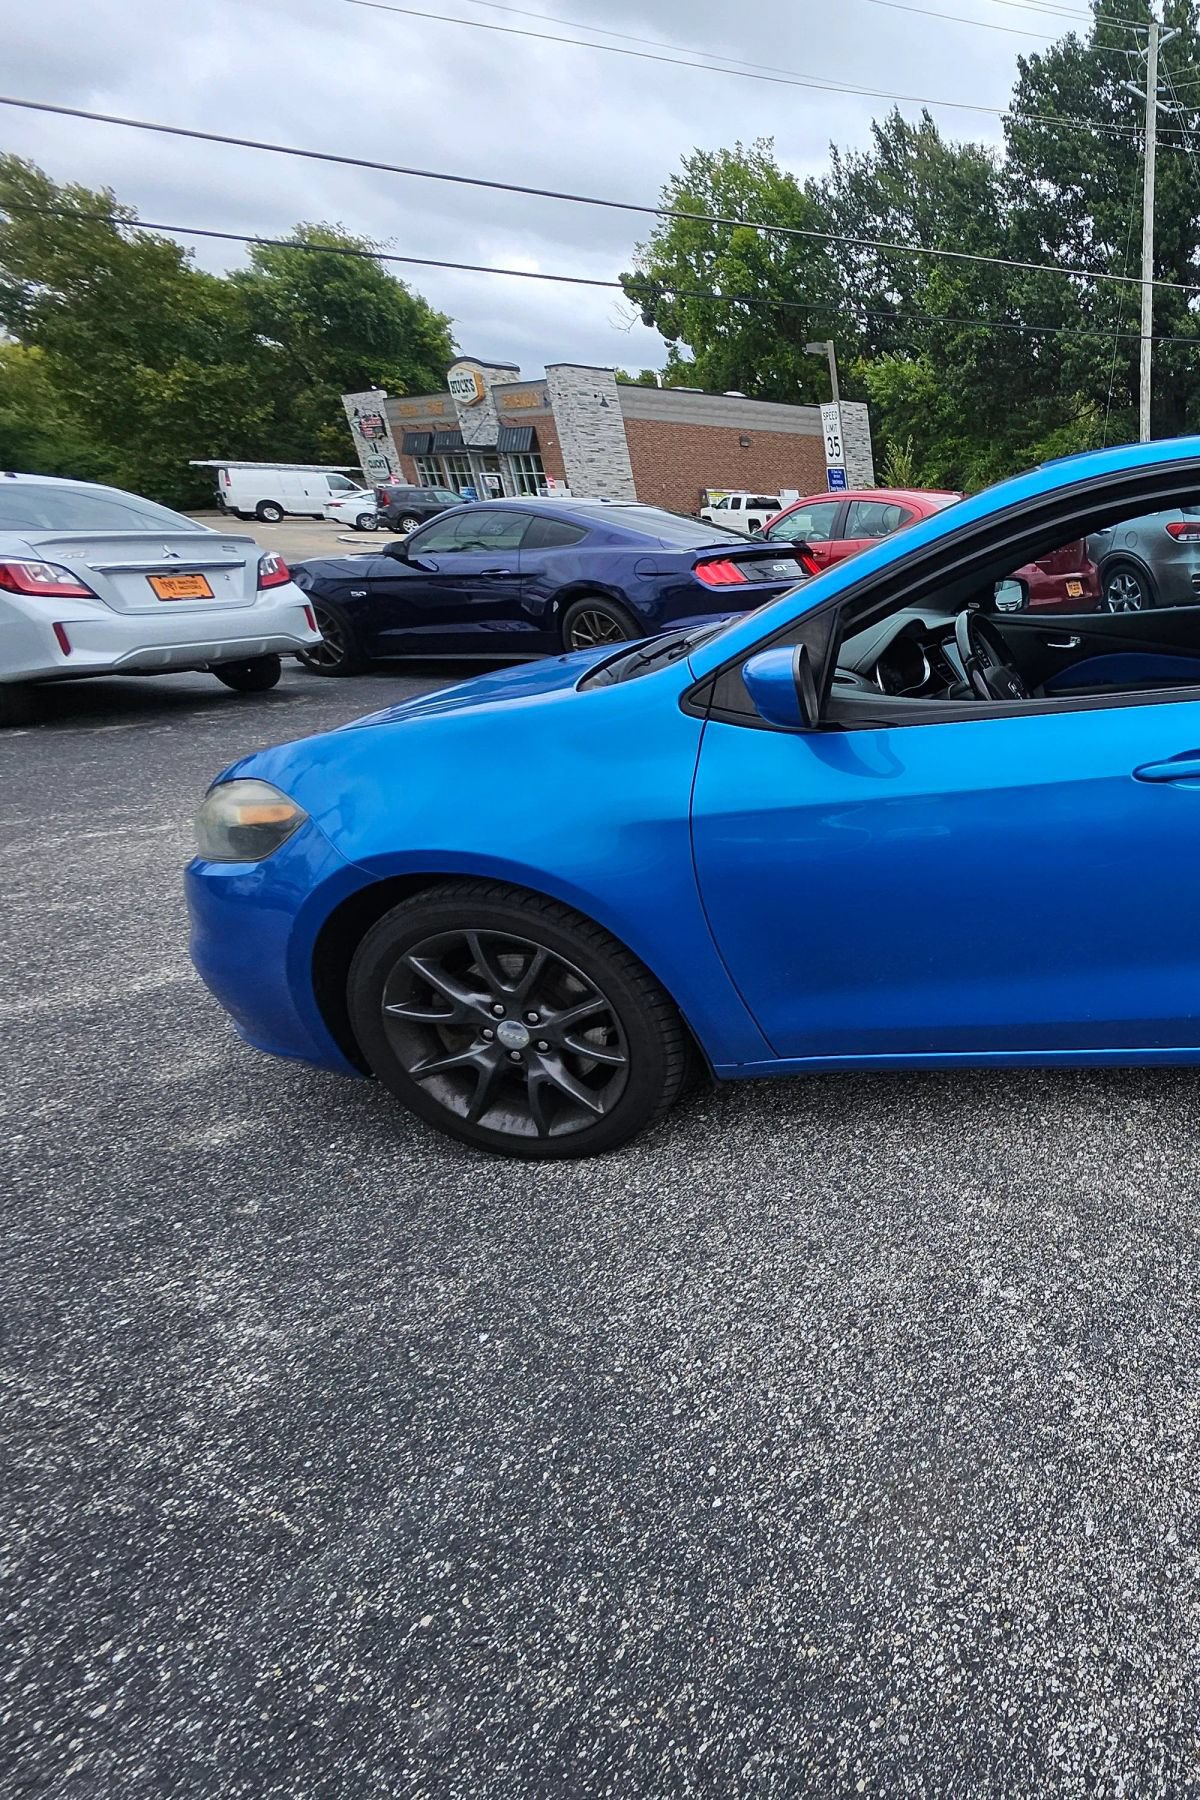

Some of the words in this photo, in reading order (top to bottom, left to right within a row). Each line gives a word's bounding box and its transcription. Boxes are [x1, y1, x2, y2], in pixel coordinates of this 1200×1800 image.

[823, 411, 838, 420] SPEED
[826, 423, 838, 433] LIMIT
[827, 436, 841, 457] 35
